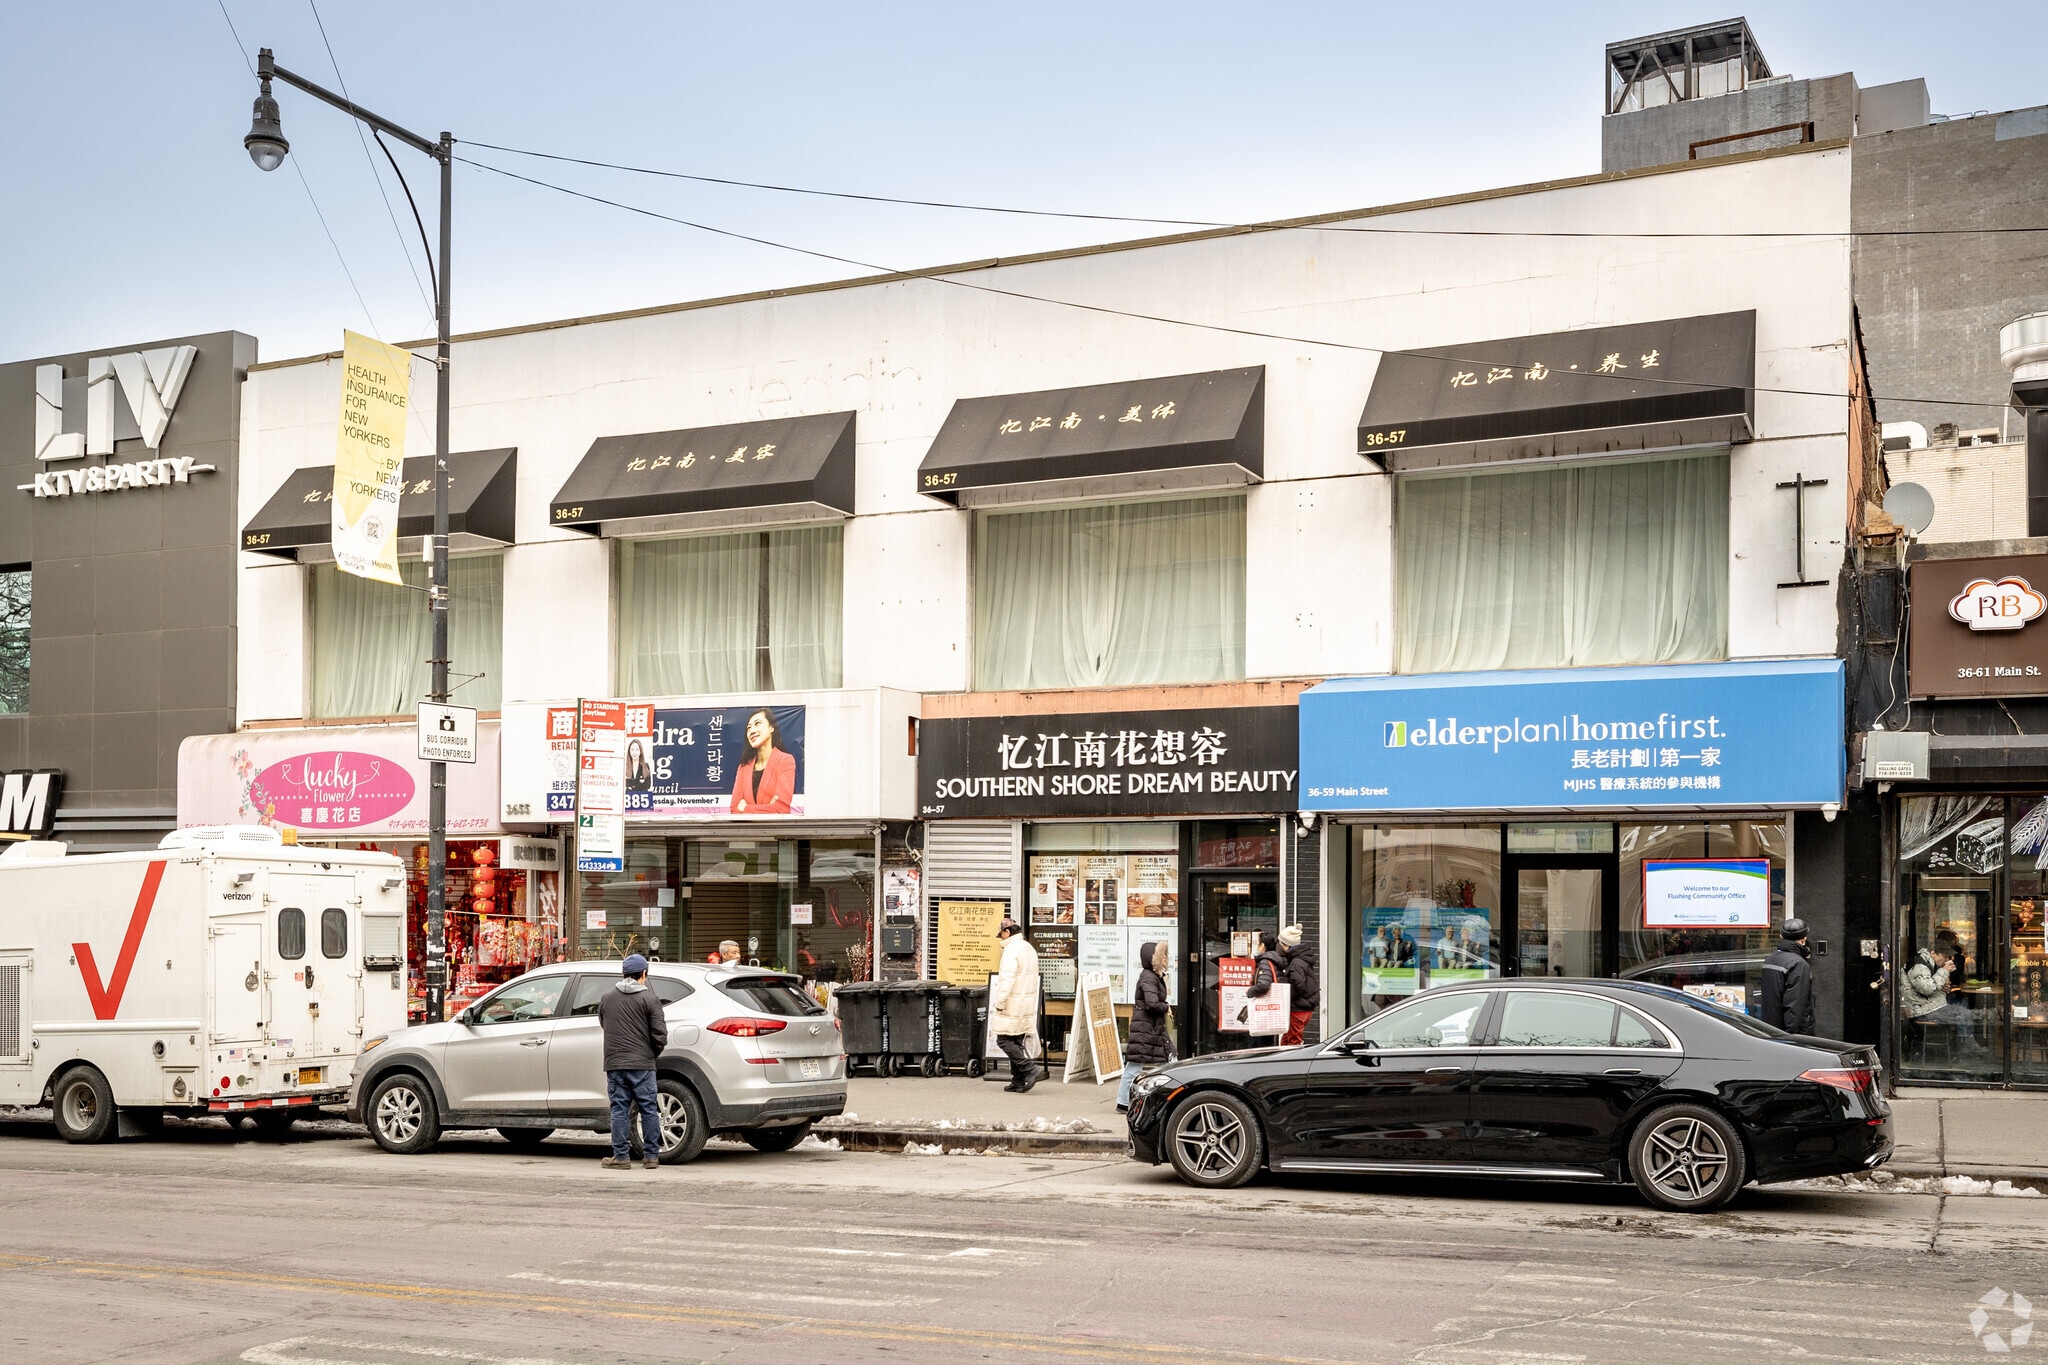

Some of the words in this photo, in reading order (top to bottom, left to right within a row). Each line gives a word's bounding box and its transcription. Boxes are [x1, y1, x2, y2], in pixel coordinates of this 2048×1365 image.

[348, 363, 386, 385] HEALTH
[346, 379, 406, 407] INSURANCE
[35, 345, 197, 460] LIV
[345, 394, 366, 410] FOR
[344, 410, 368, 426] NEW
[343, 425, 390, 449] YORKERS
[1366, 430, 1406, 446] 36-57
[386, 459, 400, 471] BY
[34, 456, 195, 498] KTV&PARTY
[376, 471, 399, 486] NEW
[924, 473, 958, 487] 36-57
[350, 480, 397, 504] YORKERS
[555, 507, 583, 520] 36-57
[246, 534, 271, 545] 36-57
[1979, 595, 2021, 618] RB
[1958, 667, 1990, 678] 36-61
[1995, 667, 2022, 677] Main
[2026, 666, 2042, 676] St.
[427, 734, 443, 743] BUS
[440, 735, 467, 746] CORRIDOR
[551, 741, 577, 751] RETAIL
[423, 747, 441, 757] PHOTO
[443, 748, 471, 759] ENFORCED
[997, 726, 1229, 771] 忆江南花想容
[304, 753, 357, 802] lucky
[935, 775, 1044, 799] SOUTHERN
[1050, 773, 1121, 797] SHORE
[1127, 772, 1203, 796] DREAM
[1211, 770, 1297, 794] BEAUTY
[1308, 788, 1334, 797] 36-59
[1336, 787, 1358, 796] Main
[1360, 787, 1389, 796] Street
[1564, 778, 1596, 792] MJHS
[314, 789, 345, 803] Flower
[300, 807, 361, 823] 喜慶花店
[922, 805, 944, 814] 36-57
[579, 862, 606, 870] 443334
[223, 892, 251, 901] verizon
[949, 906, 995, 916] 忆江南花想容
